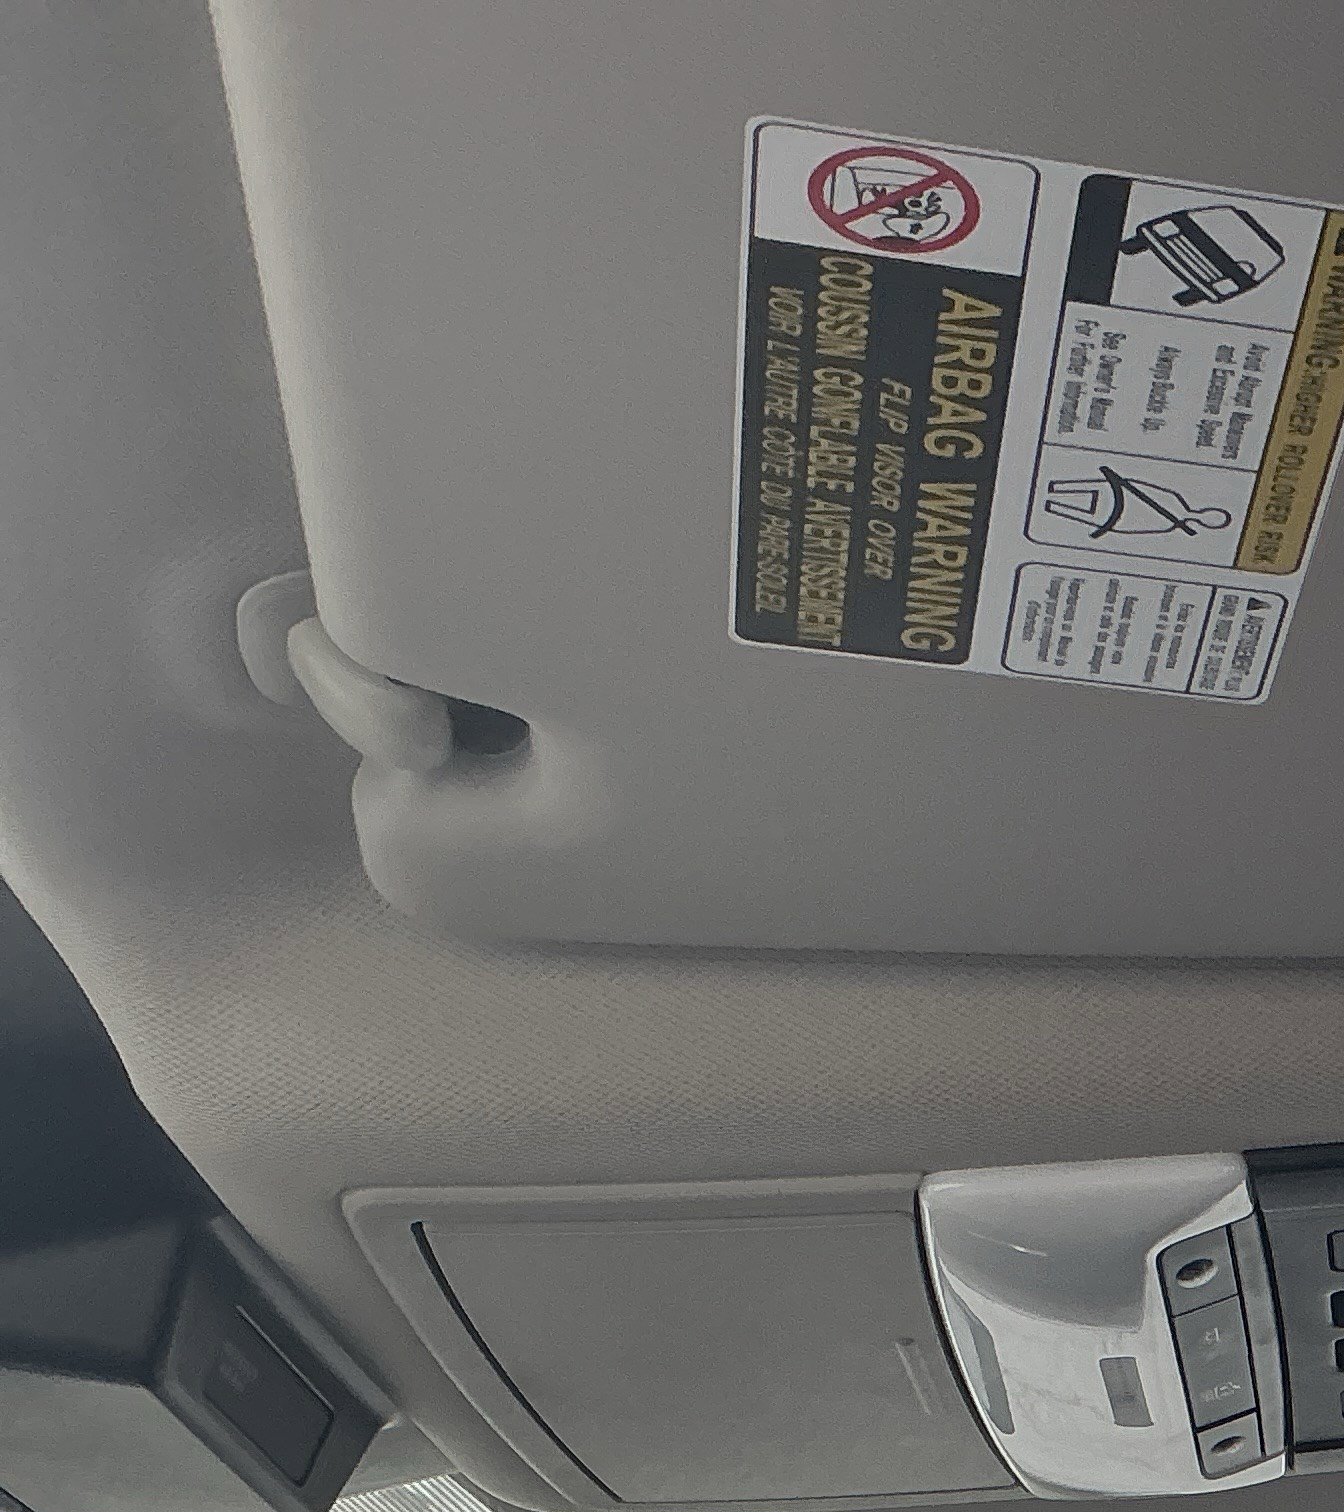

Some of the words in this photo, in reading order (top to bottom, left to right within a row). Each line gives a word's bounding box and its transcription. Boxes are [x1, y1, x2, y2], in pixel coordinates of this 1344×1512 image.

[767, 284, 804, 337] VOIR
[814, 255, 873, 360] COUSSIN
[763, 340, 800, 423] L'AUTRE
[875, 377, 912, 434] FLIP
[921, 287, 1004, 462] AIRBAG
[1285, 373, 1328, 437] HIGHER
[805, 364, 864, 494] GONFLABLE
[759, 480, 792, 509] DU
[868, 441, 905, 512] VISOR
[1261, 442, 1309, 524] ROLLOVER
[795, 496, 853, 646] AVERTISSEMENT
[862, 518, 897, 581] OVER
[899, 476, 978, 655] WARNING
[1250, 529, 1283, 565] RISK
